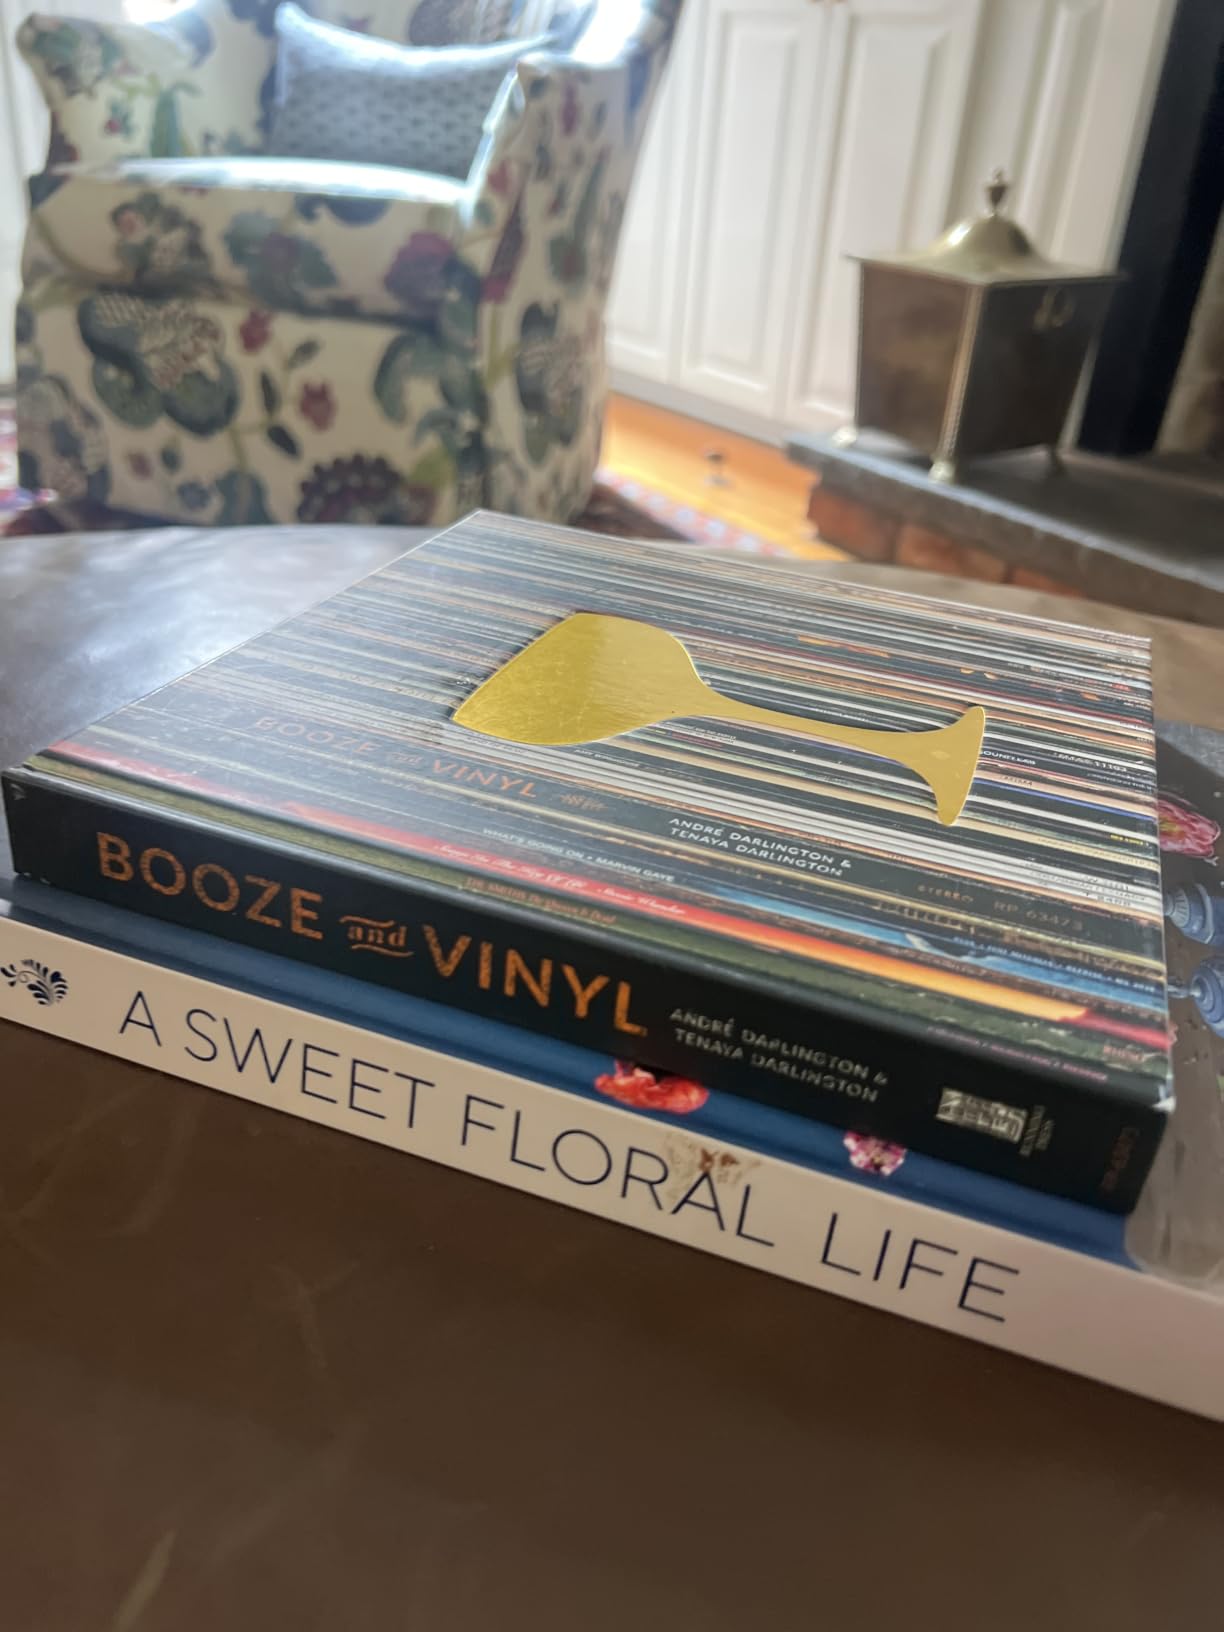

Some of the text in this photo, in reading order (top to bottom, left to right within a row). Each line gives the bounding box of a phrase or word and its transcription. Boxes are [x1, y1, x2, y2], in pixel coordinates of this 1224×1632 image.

[255, 716, 382, 755] BOOZE
[432, 759, 537, 798] VINYL
[669, 818, 852, 868] ANDRÉ DARLINGTON &
[670, 828, 843, 876] TENAYA DARLINGTON
[96, 832, 648, 1036] BOOZE and VINYL
[670, 1008, 889, 1086] ANDRÉ DARLINGTON &
[675, 1028, 744, 1060] TENAYA
[750, 1053, 879, 1103] DARLINGTON
[119, 991, 1020, 1323] A SWEET FLORAL LIFE
